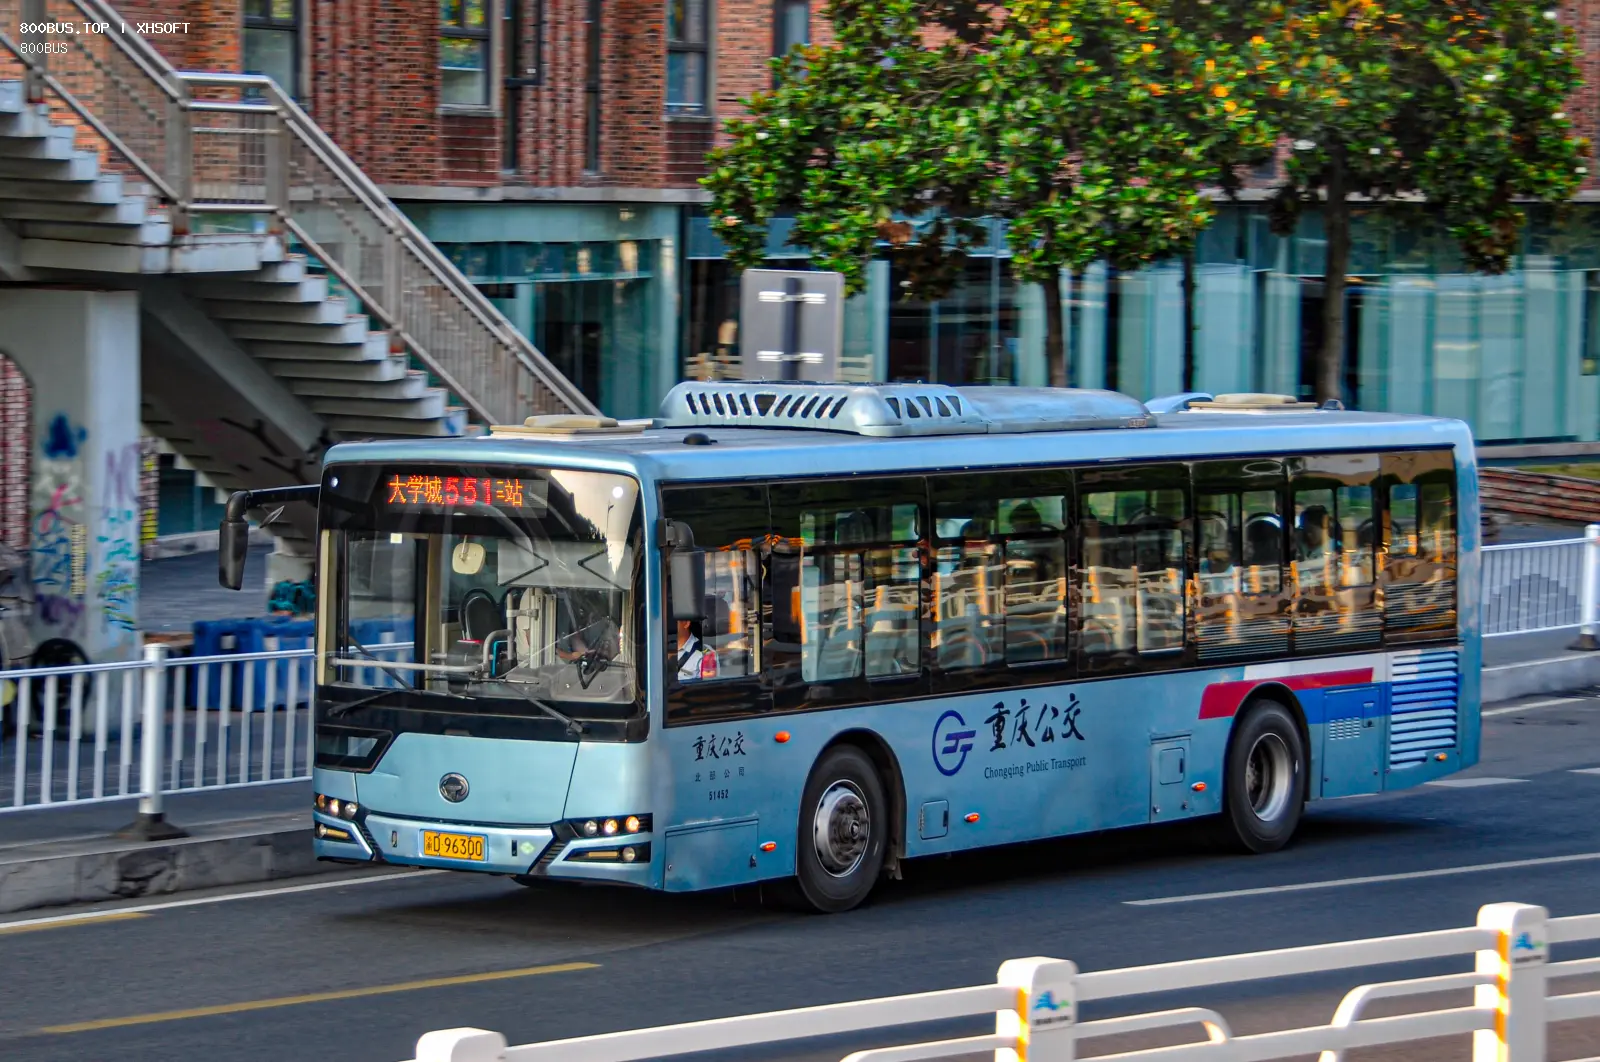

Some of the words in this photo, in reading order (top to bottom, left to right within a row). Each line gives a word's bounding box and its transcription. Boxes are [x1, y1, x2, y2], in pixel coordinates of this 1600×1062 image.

[387, 474, 444, 505] 大学城
[445, 476, 492, 506] 551
[984, 692, 1086, 752] 重庆公交
[692, 731, 746, 761] 重庆公交
[983, 763, 1025, 780] Chongqing
[1026, 760, 1049, 774] Public
[1051, 756, 1087, 771] Transport
[708, 788, 729, 801] 51452
